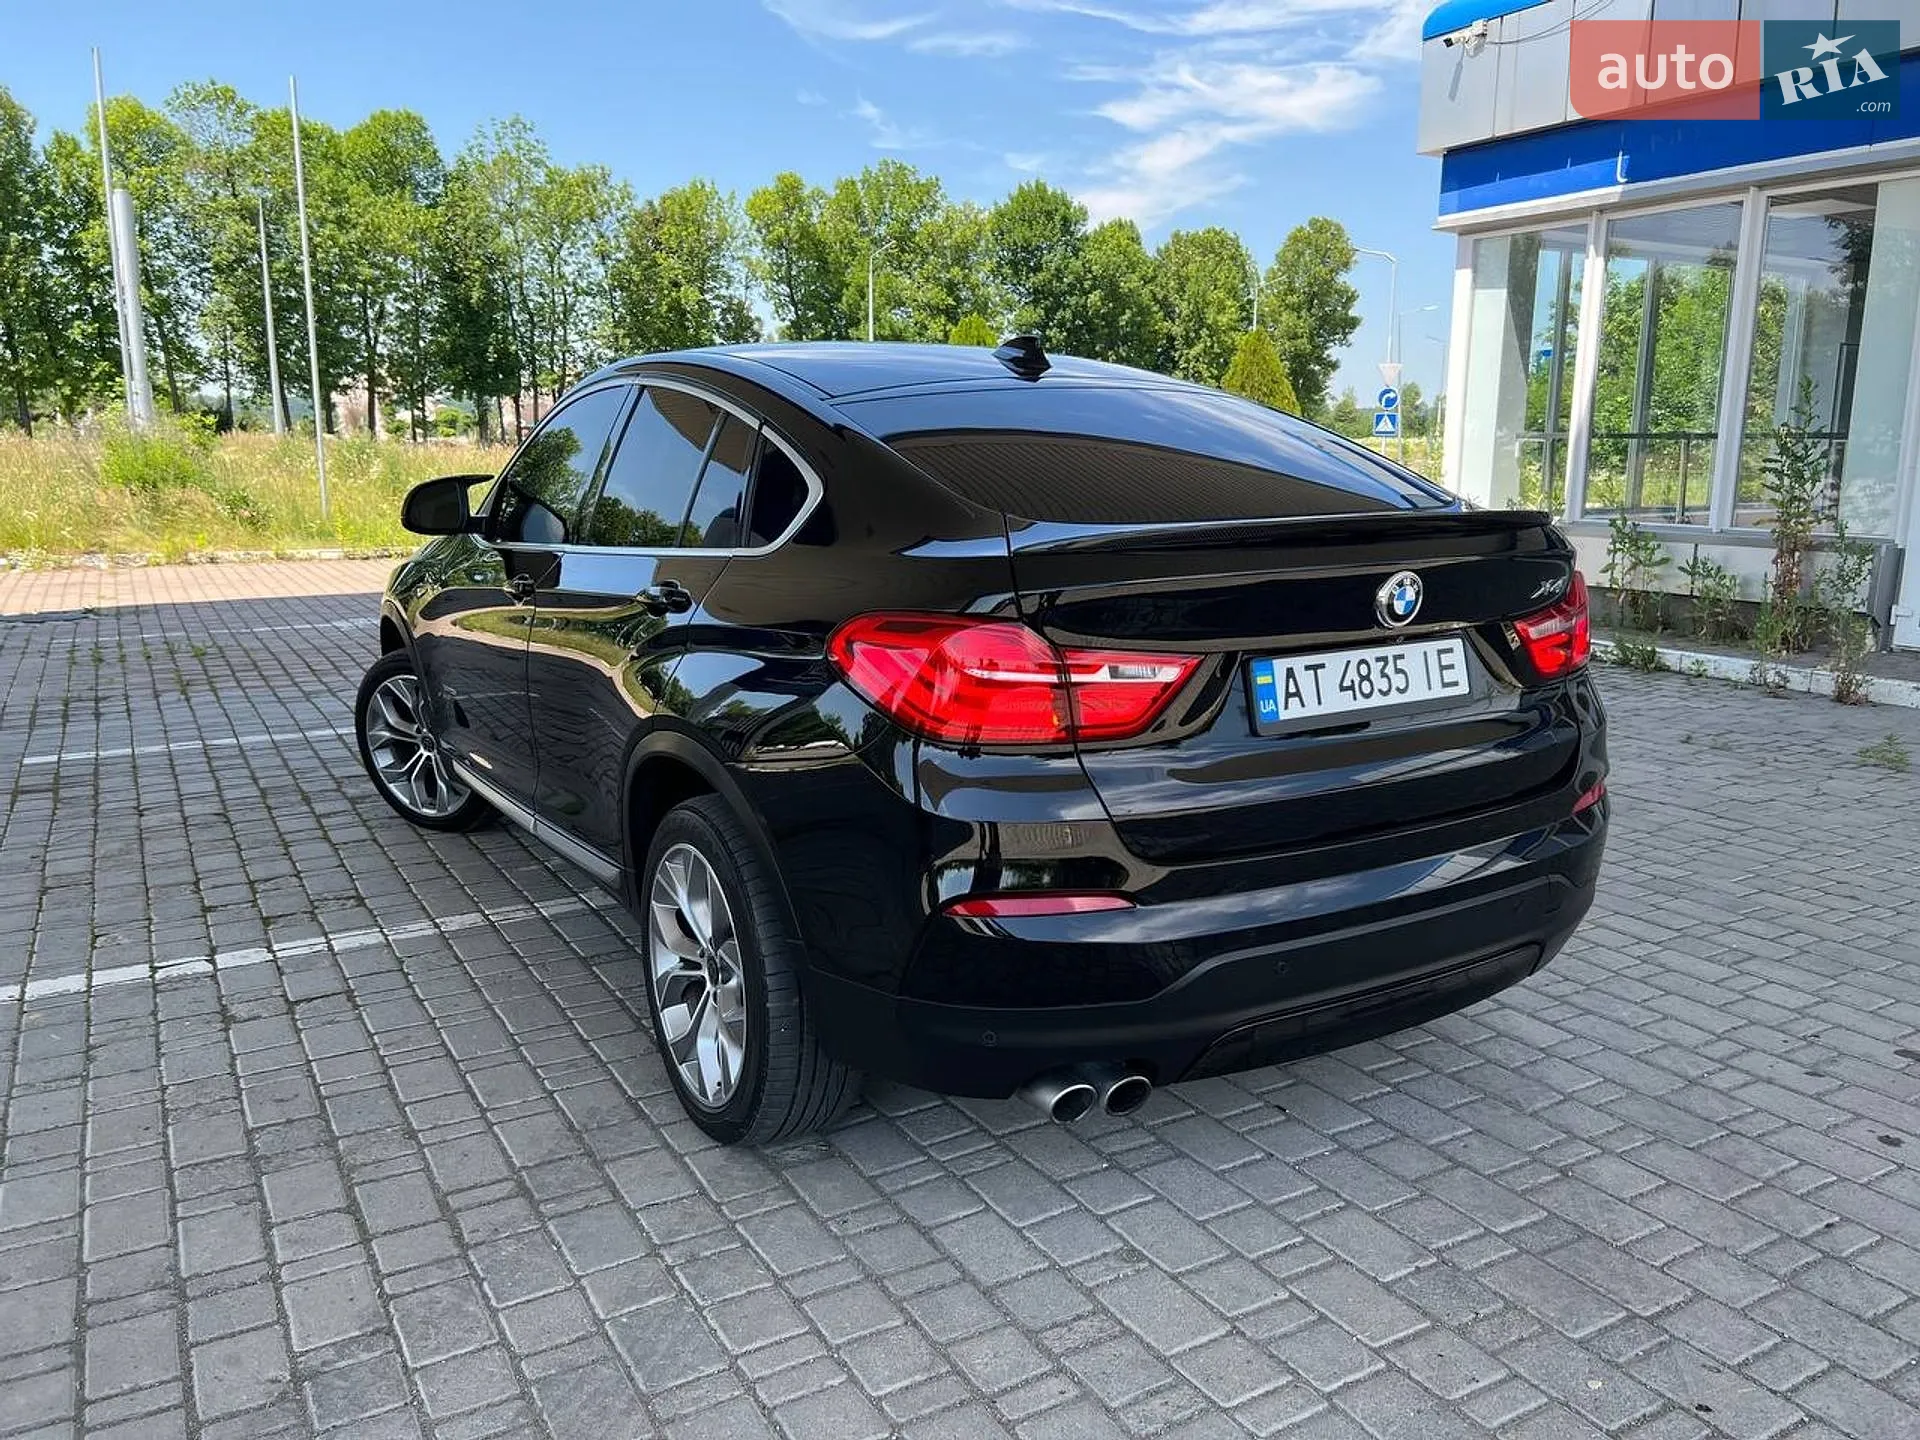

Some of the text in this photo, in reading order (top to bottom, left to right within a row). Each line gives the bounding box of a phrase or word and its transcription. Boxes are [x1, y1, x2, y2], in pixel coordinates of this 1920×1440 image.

[1284, 647, 1460, 710] AT 4835 IE
[1260, 698, 1277, 713] UA
